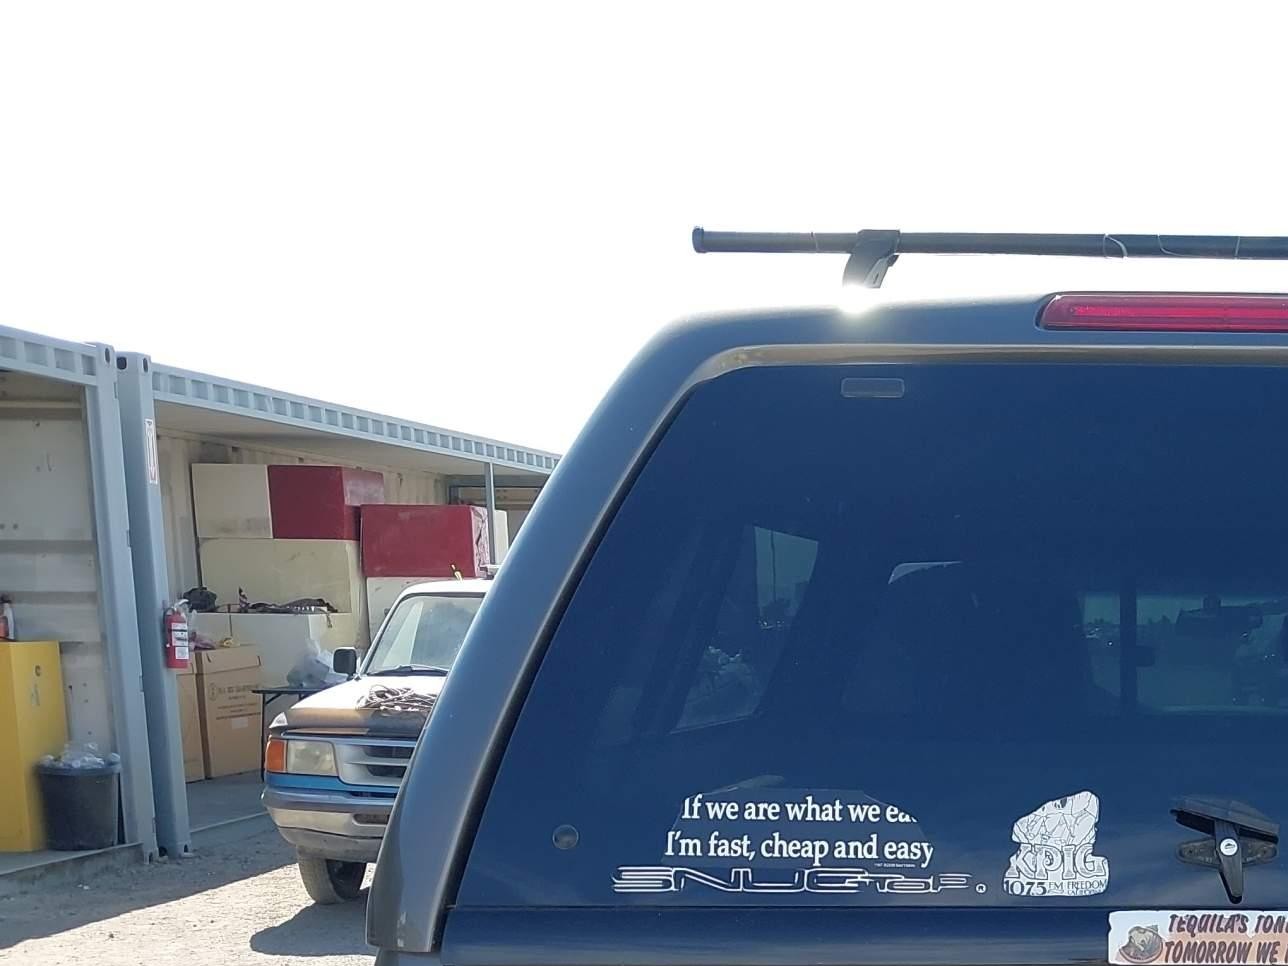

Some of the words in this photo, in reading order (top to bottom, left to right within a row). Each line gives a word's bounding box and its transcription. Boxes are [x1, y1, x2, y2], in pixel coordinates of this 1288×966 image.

[682, 793, 702, 819] If
[705, 801, 739, 820] we
[743, 801, 781, 820] are
[786, 795, 843, 822] what
[848, 803, 881, 822] we
[885, 805, 918, 823] ea
[664, 830, 702, 856] I'm
[708, 830, 756, 860] fast,
[760, 832, 829, 866] cheap
[833, 833, 879, 860] and
[883, 841, 934, 869] easy
[1004, 843, 1107, 880] KPIG
[1168, 914, 1249, 937] TEQUILA'S
[1165, 940, 1252, 964] TOMORROW
[1256, 942, 1280, 963] WE
